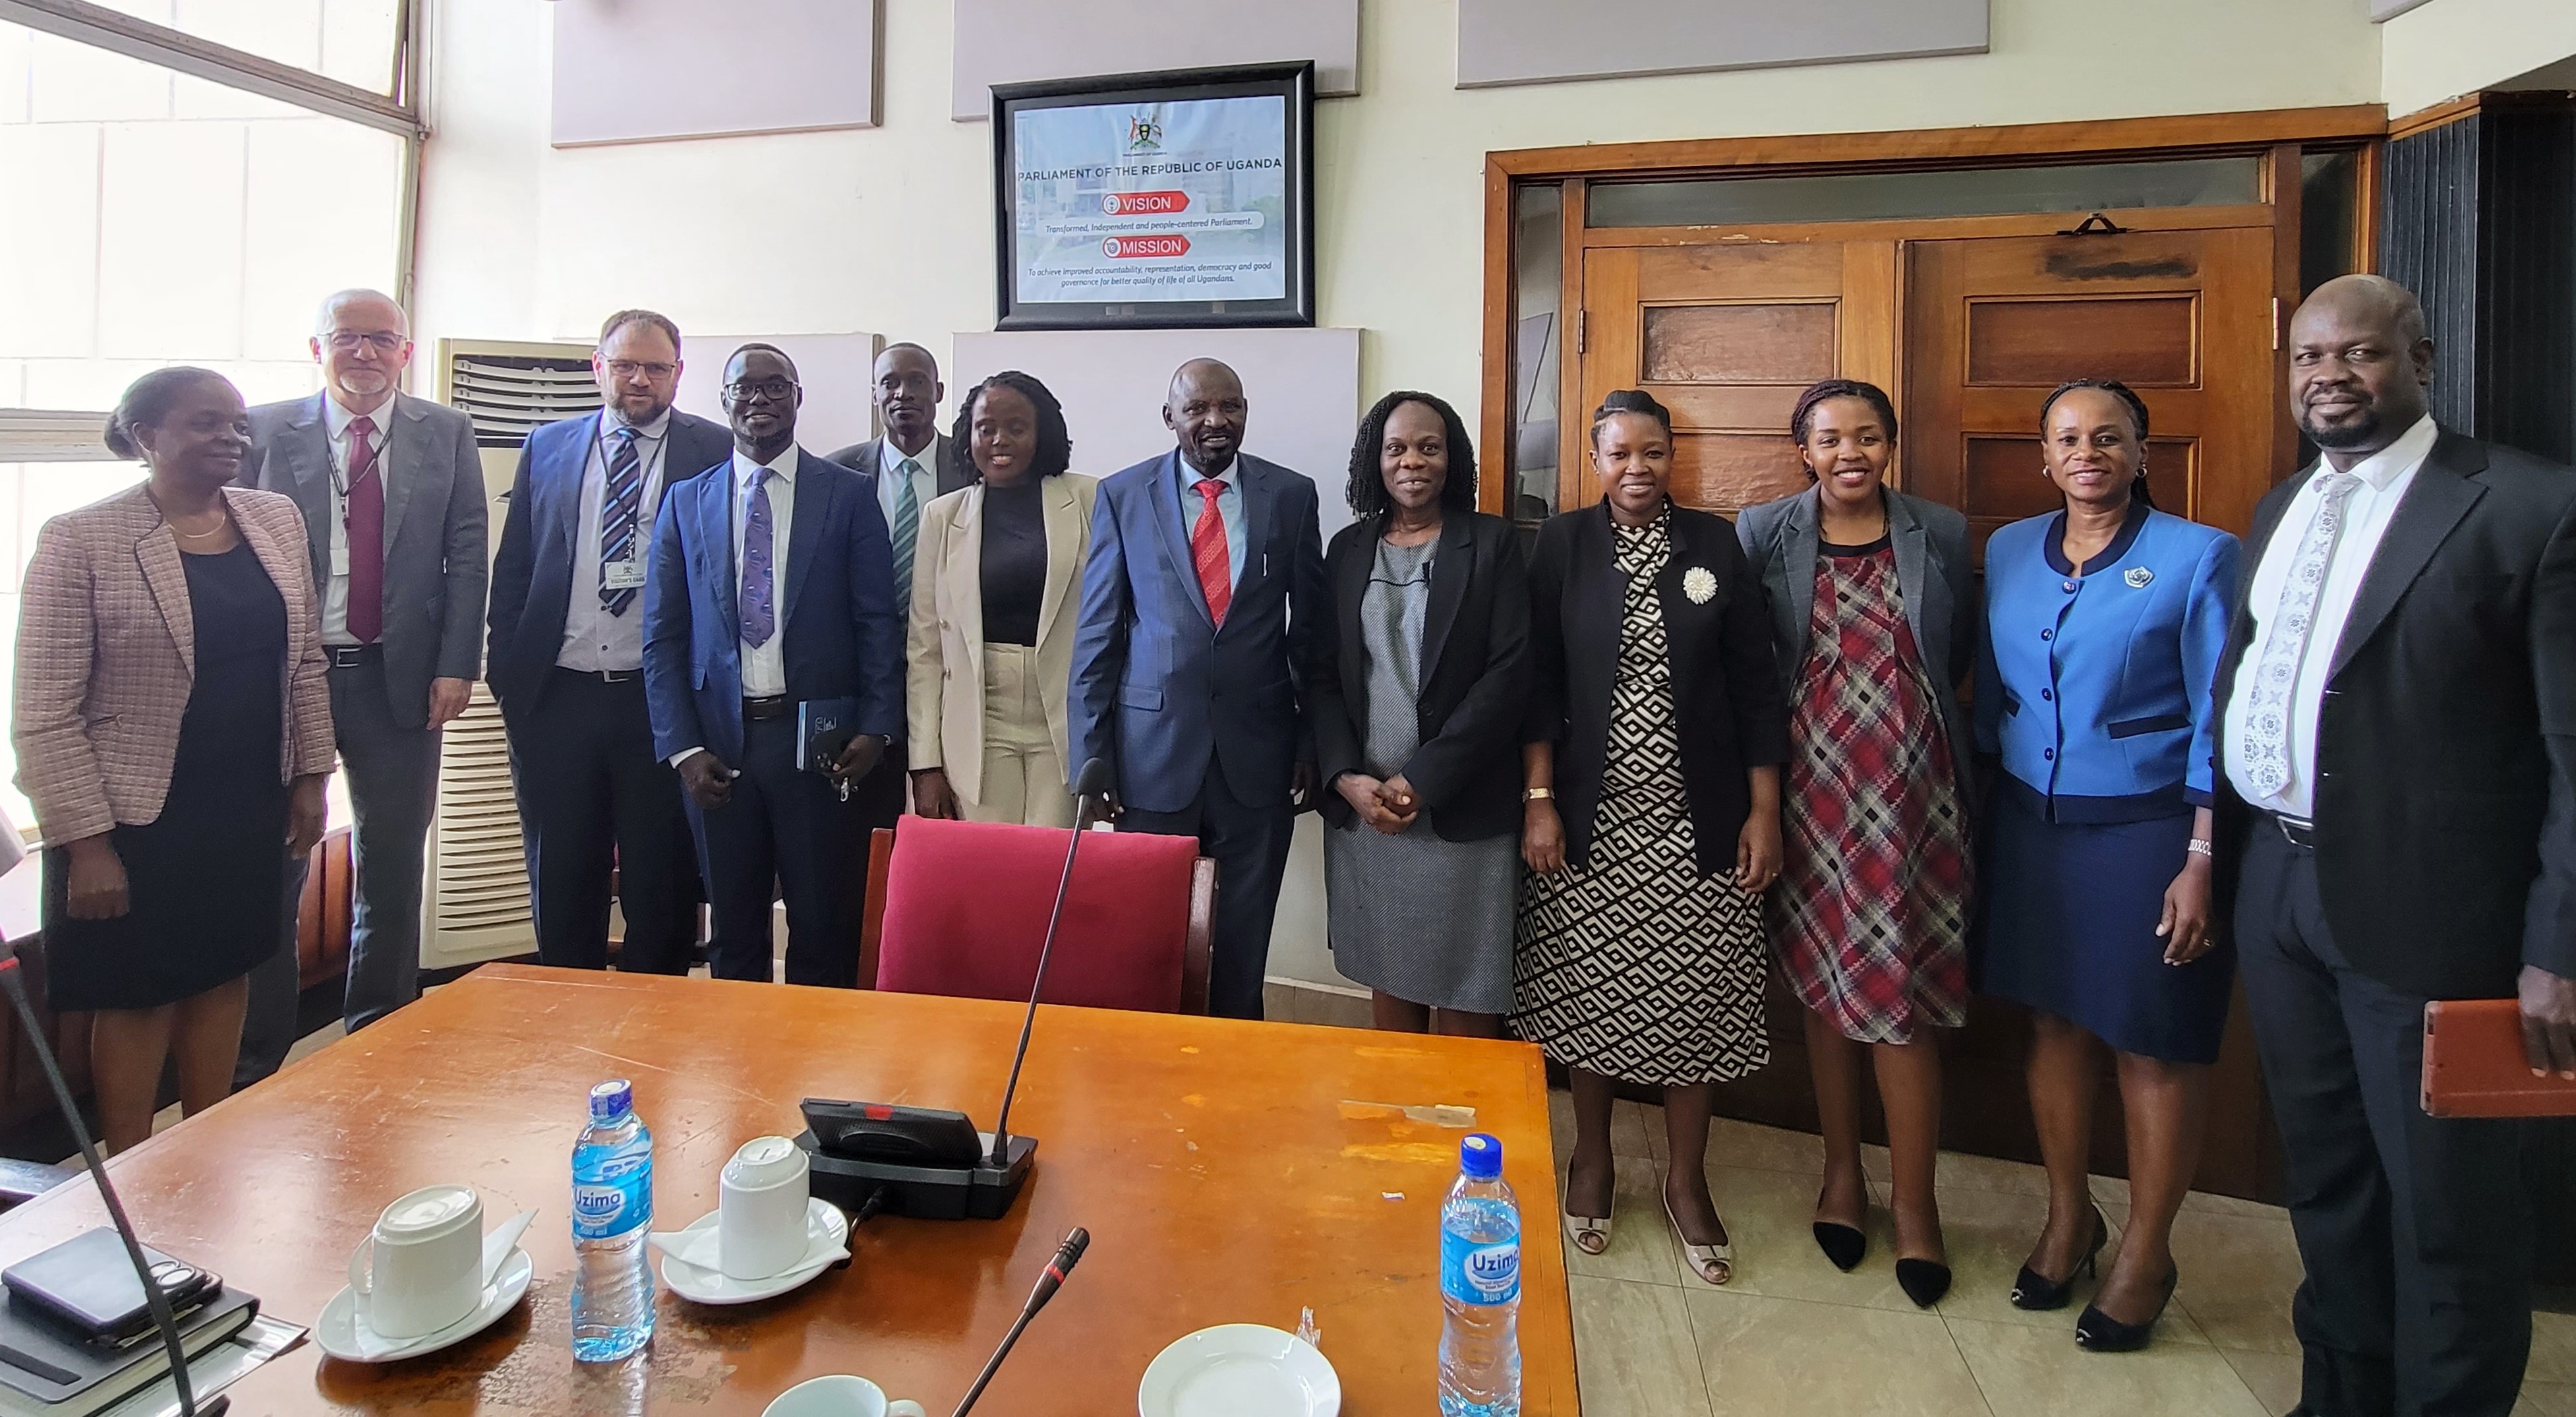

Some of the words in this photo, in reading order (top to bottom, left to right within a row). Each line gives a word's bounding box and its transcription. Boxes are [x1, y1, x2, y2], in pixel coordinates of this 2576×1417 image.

[1018, 168, 1091, 181] PARLIAMENT
[1095, 167, 1112, 177] OF
[1115, 166, 1138, 177] THE
[1142, 162, 1202, 175] REPUBLIC
[1206, 161, 1223, 171] OF
[1227, 158, 1282, 170] UGANDA
[1123, 196, 1171, 211] VISION
[1046, 224, 1089, 233] Transformed,
[1092, 223, 1134, 231] Independent
[1151, 220, 1209, 230] people-centered
[1211, 218, 1252, 227] Parliament.
[1123, 239, 1182, 255] MISSION
[1037, 268, 1061, 276] achieve
[1063, 267, 1094, 276] improved
[1095, 266, 1142, 275] accountability,
[1144, 264, 1196, 274] representation,
[1198, 263, 1237, 272] democracy
[1253, 261, 1272, 271] good
[1061, 279, 1098, 287] governance
[1100, 278, 1110, 287] for
[1132, 276, 1156, 286] quality
[1157, 276, 1165, 285] of
[1166, 275, 1177, 285] life
[1179, 276, 1185, 284] of
[1197, 274, 1235, 284] Ugandans.
[575, 1188, 620, 1207] Uzima
[1473, 1249, 1519, 1271] Uzima
[1483, 1292, 1501, 1302] 500
